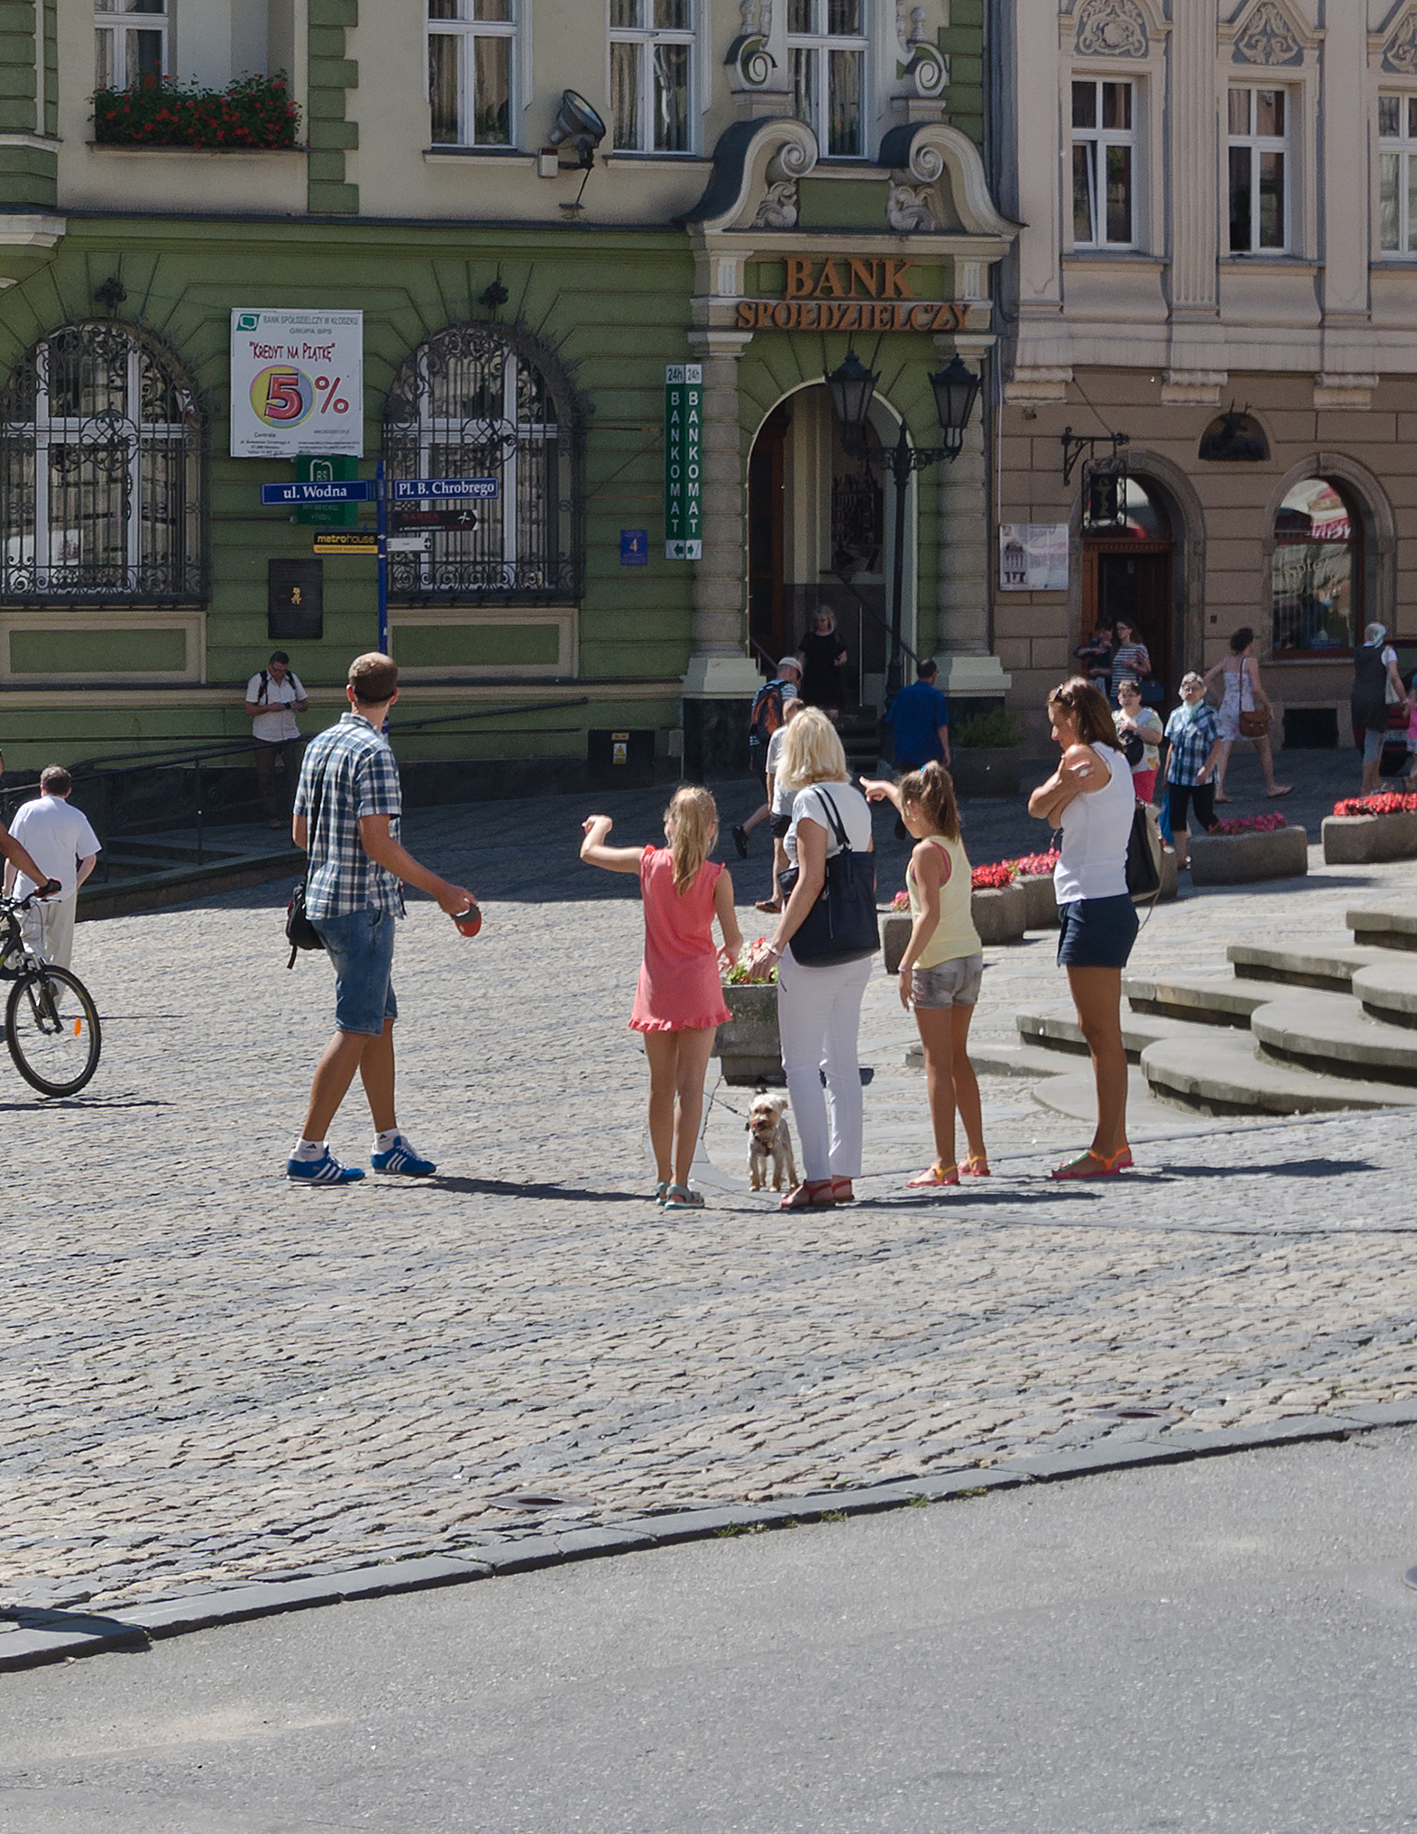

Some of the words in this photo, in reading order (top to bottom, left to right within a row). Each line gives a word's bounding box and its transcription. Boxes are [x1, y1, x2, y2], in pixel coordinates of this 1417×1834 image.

[785, 256, 922, 302] BANK
[263, 315, 280, 325] BANK
[737, 298, 973, 331] SPÓŁDZIELCZY
[287, 346, 299, 359] NA
[667, 368, 683, 382] 24h
[687, 368, 701, 382] 24h
[670, 391, 680, 534] BANKOMAT
[688, 391, 700, 534] BANKOMAT
[283, 486, 300, 499] ul.
[302, 484, 347, 498] Wodna
[398, 483, 415, 496] Pl.
[417, 483, 429, 495] B.
[431, 481, 496, 496] Chrobrego
[316, 534, 376, 544] metrohouse
